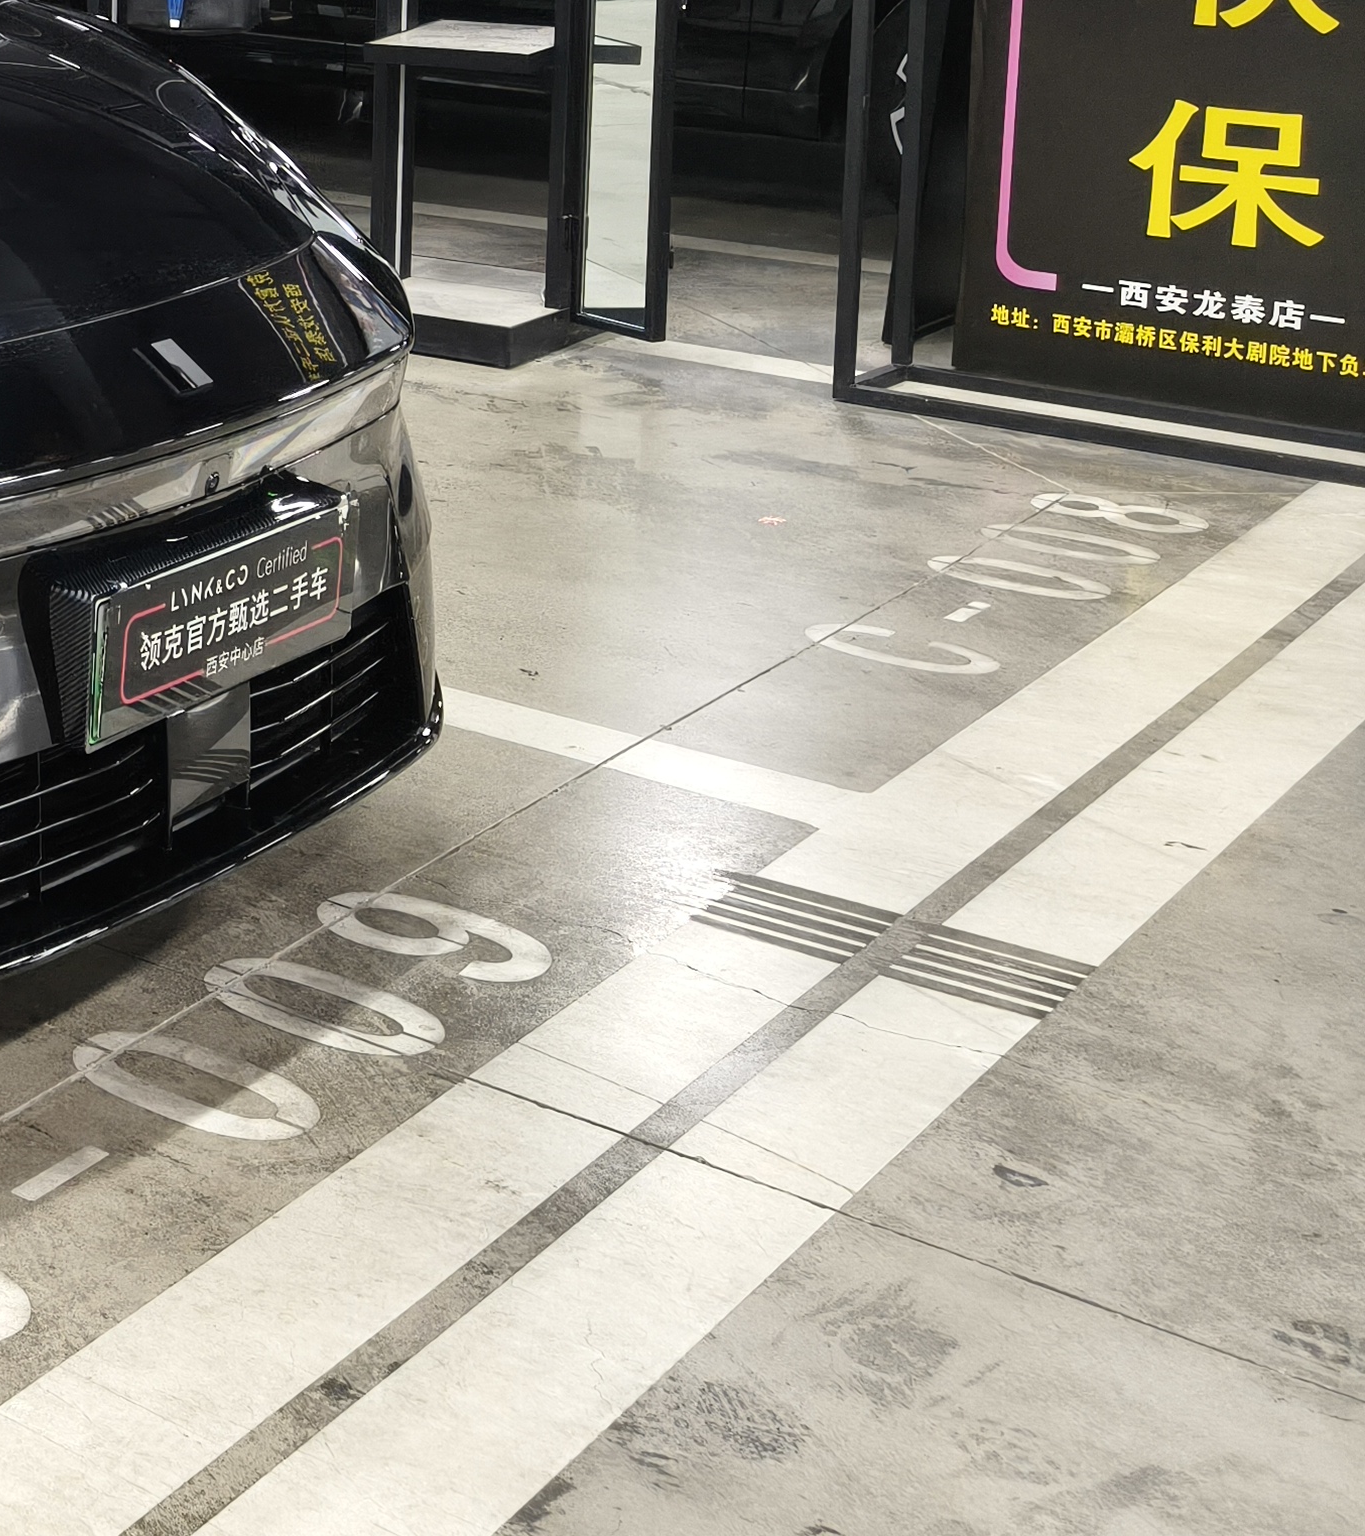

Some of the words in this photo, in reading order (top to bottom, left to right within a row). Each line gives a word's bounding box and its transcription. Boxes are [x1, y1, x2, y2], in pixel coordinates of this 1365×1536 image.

[990, 303, 1365, 378] 地址：西安市灞桥区保利大剧院地下负
[170, 564, 249, 612] LYNK&CO
[256, 541, 308, 579] Certified
[805, 493, 1209, 675] C-008
[139, 566, 328, 671] 领克官方甄选二手车
[205, 635, 265, 677] 西安中心店
